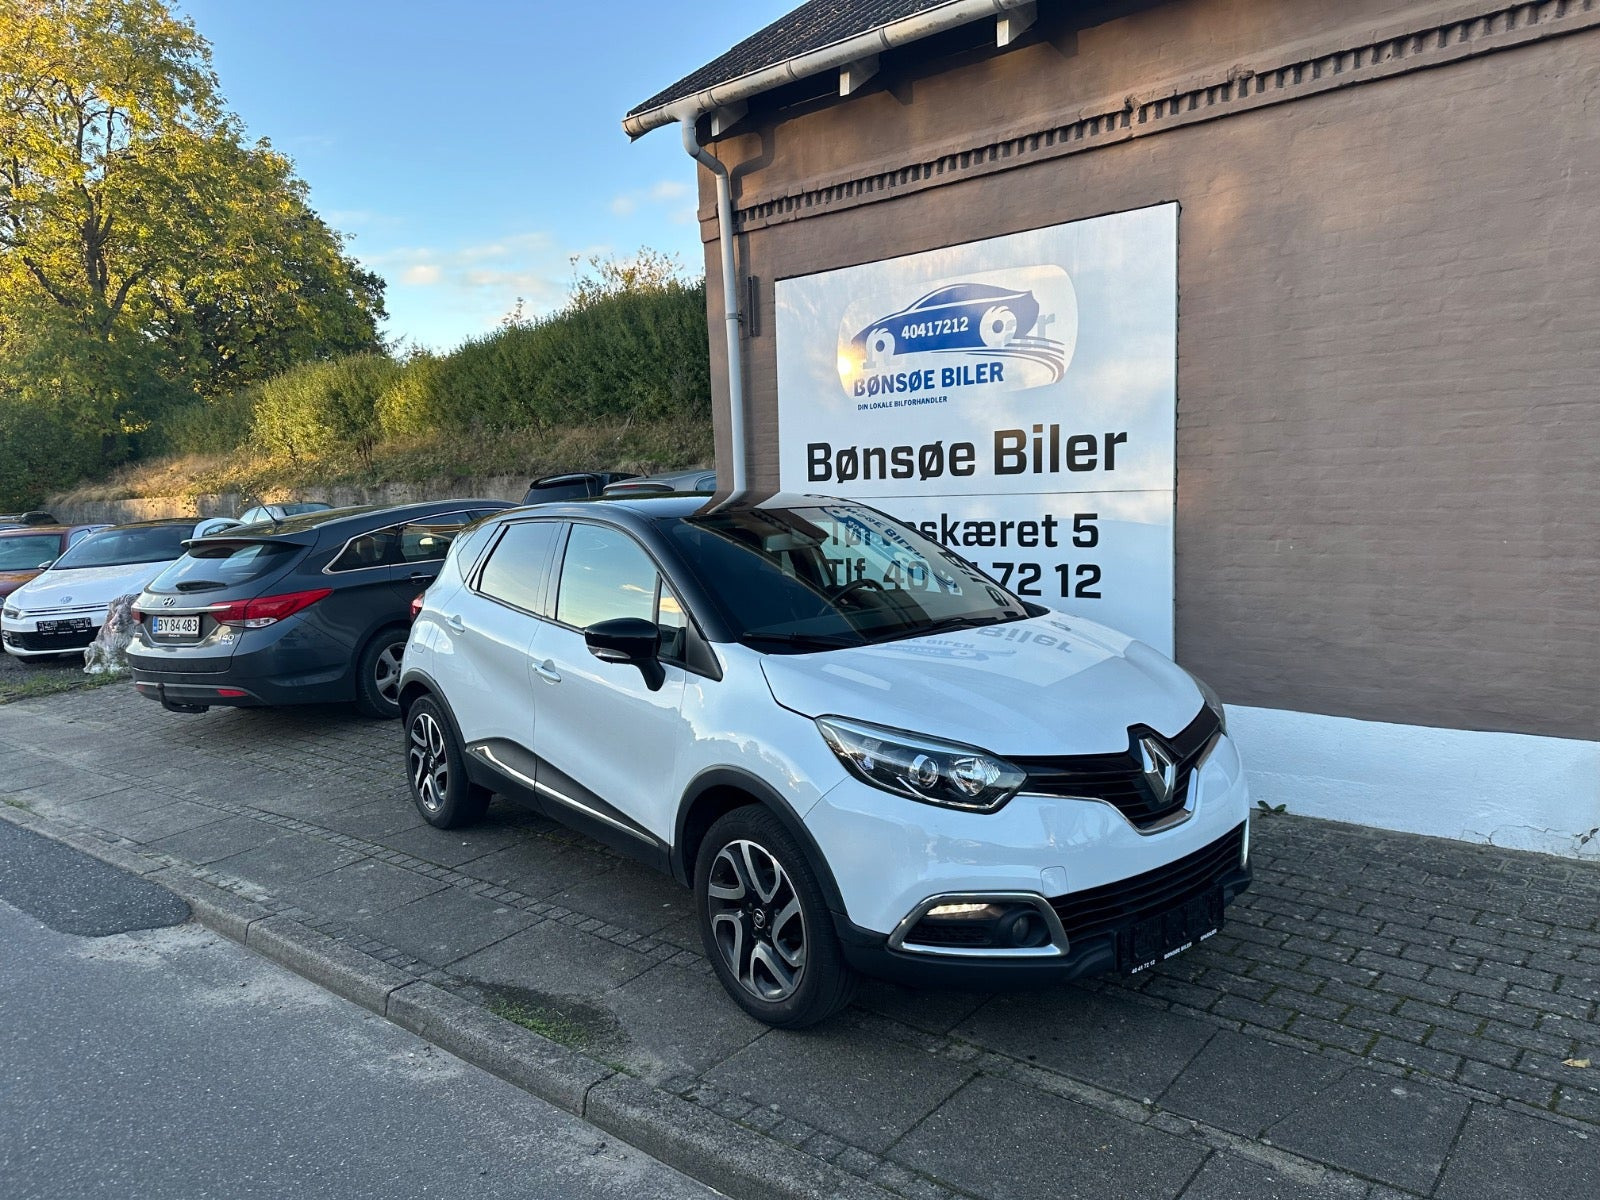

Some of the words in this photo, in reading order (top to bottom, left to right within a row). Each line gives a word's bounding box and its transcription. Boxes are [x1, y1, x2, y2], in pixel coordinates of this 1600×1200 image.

[901, 316, 969, 340] 40417212
[854, 370, 935, 397] BØNSØE
[941, 362, 1004, 387] BILER
[869, 401, 893, 410] LOKALE
[894, 396, 948, 407] BILFORHANDLER
[807, 440, 976, 484] Bønsøe
[994, 423, 1128, 476] Biler
[1072, 513, 1099, 548] 5
[992, 562, 1042, 597] 72
[1055, 563, 1102, 599] 12
[158, 619, 169, 631] BY
[170, 619, 180, 631] 84
[182, 619, 197, 631] 483
